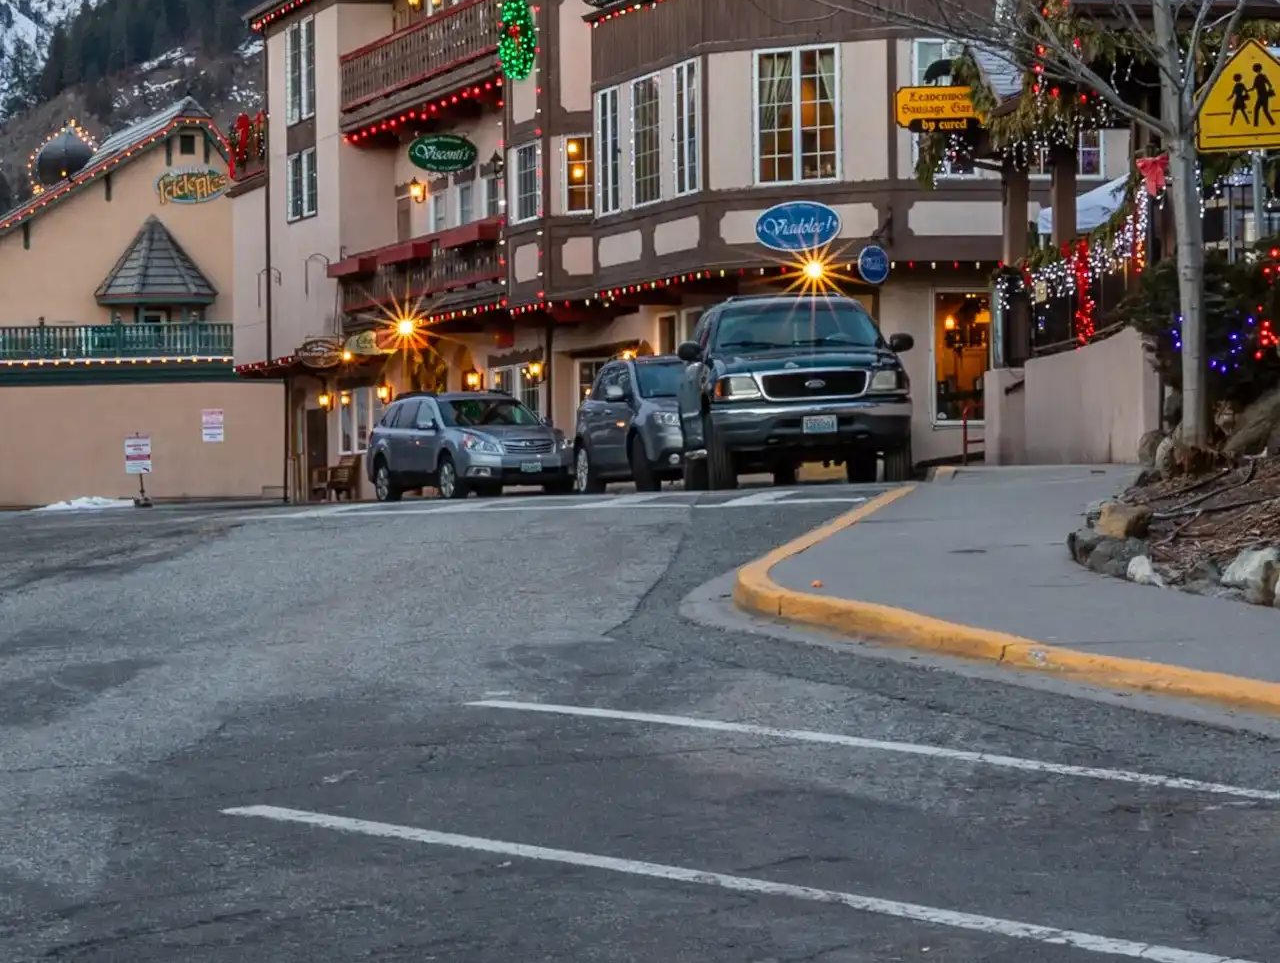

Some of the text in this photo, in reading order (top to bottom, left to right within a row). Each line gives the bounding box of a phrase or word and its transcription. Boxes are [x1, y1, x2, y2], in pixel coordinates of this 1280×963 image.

[908, 92, 967, 102] Leavenwo
[902, 102, 972, 116] Sausage Gar
[921, 117, 967, 132] by cured
[415, 144, 470, 160] Visconti's
